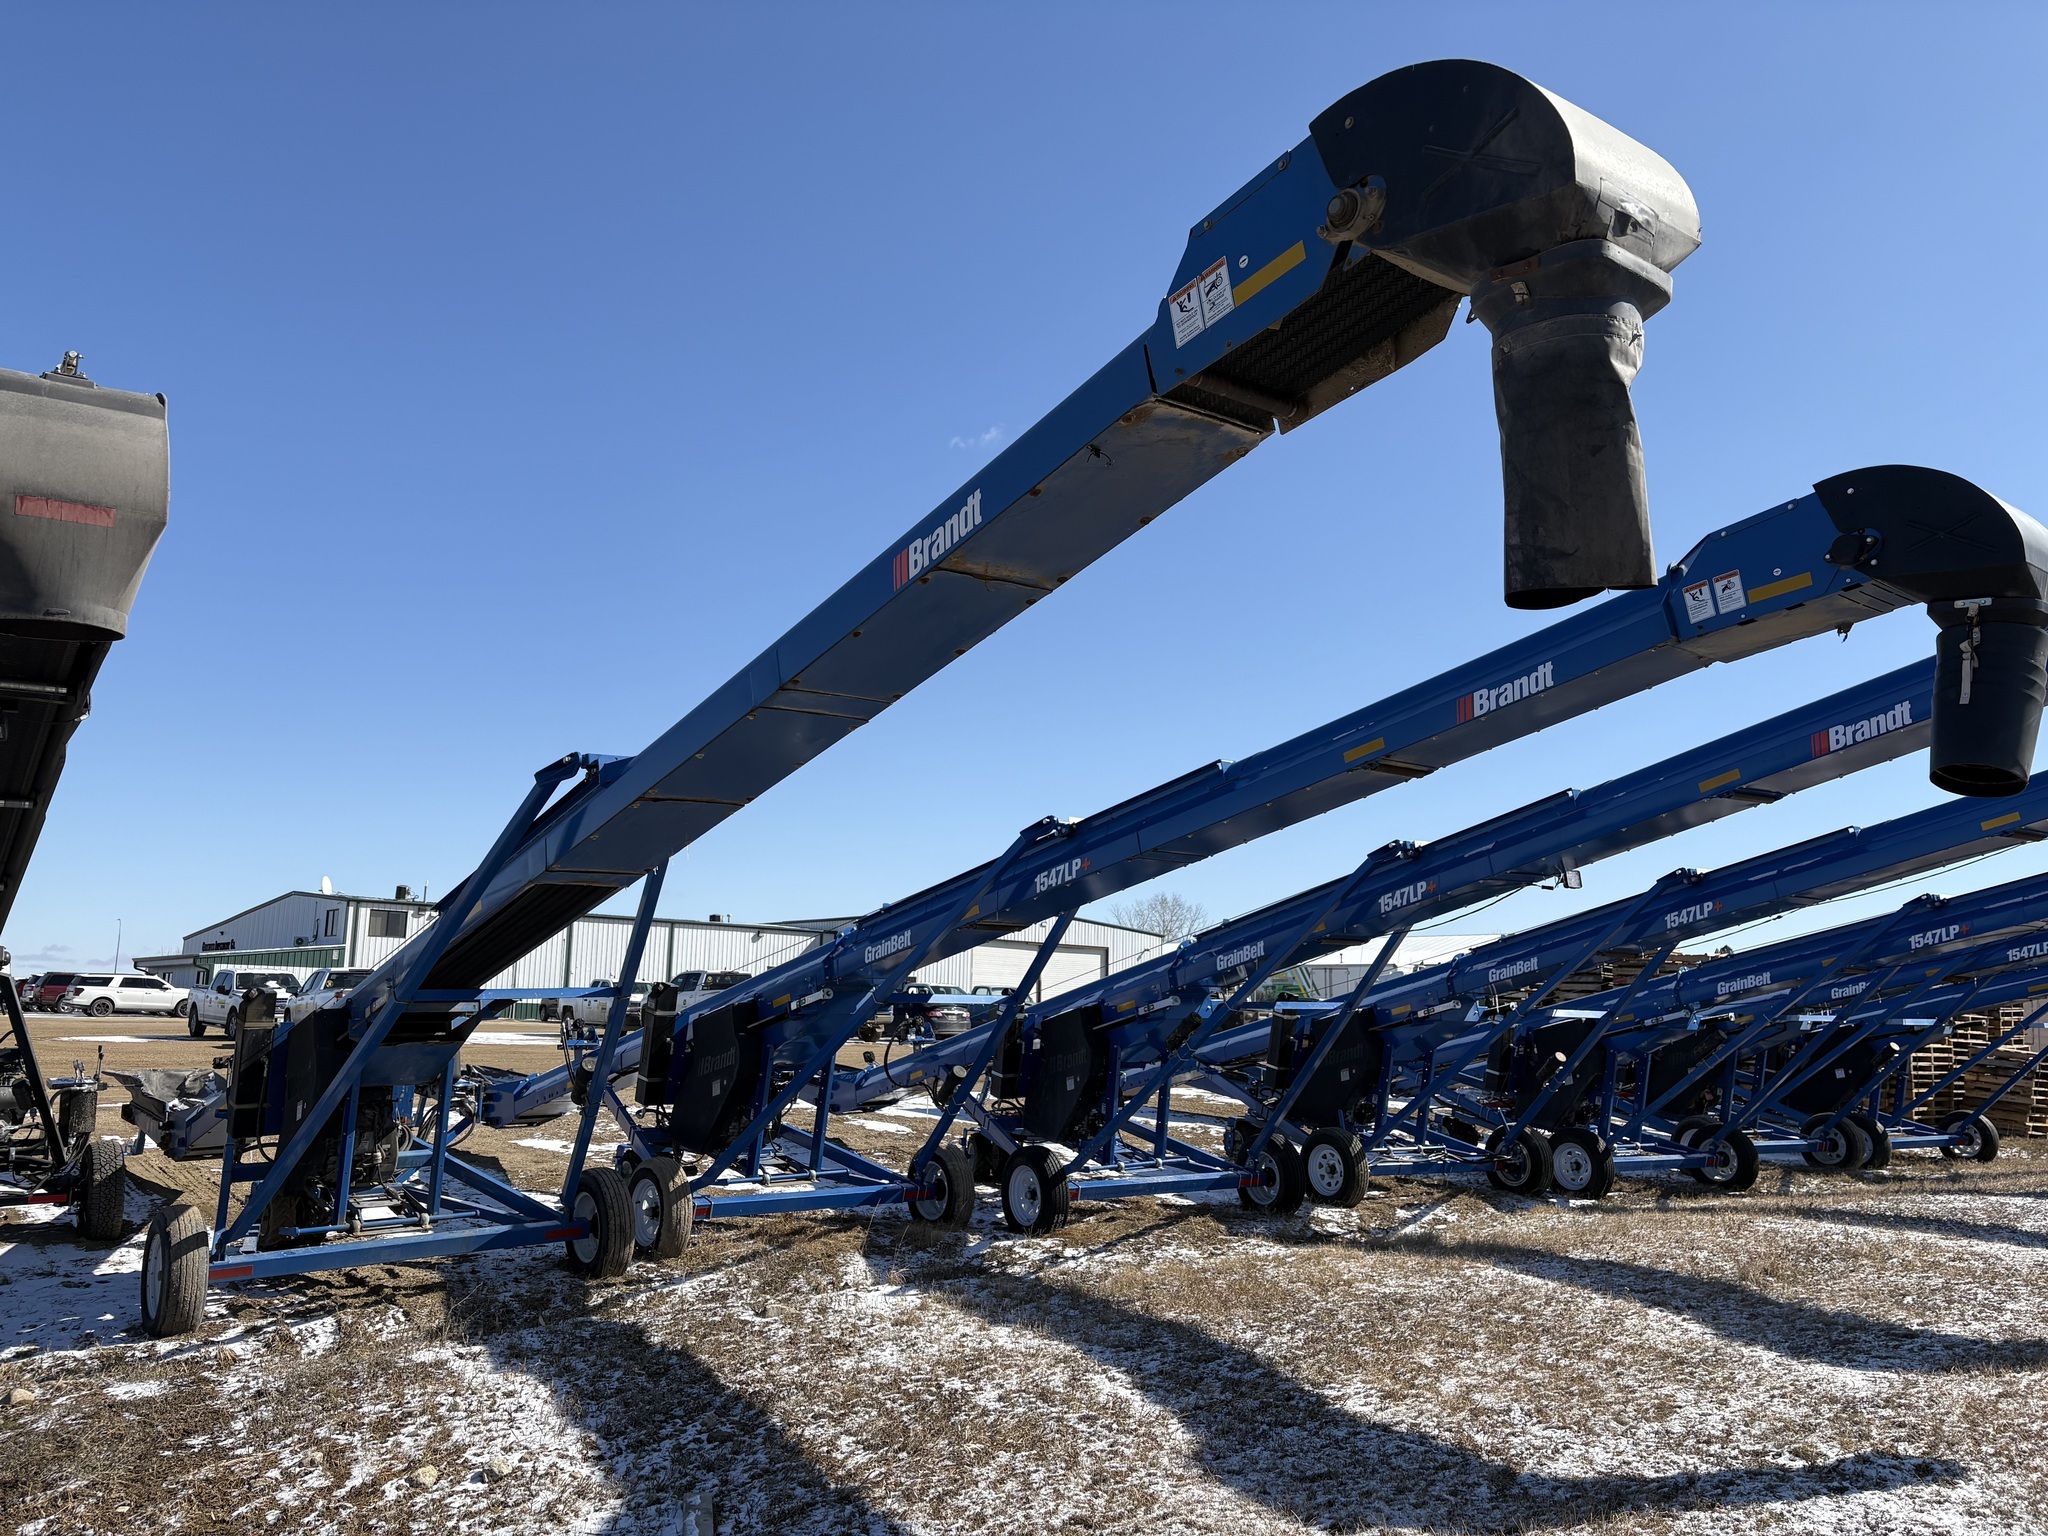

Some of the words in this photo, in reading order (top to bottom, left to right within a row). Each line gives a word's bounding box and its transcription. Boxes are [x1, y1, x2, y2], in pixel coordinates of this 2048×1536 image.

[908, 488, 982, 580] Brandt
[1473, 661, 1554, 718] Brandt
[1829, 700, 1913, 752] Brandt
[864, 930, 912, 964] GrainBelt
[1216, 940, 1265, 972] GrainBelt
[1488, 957, 1539, 983] GrainBelt
[1717, 972, 1772, 996] GrainBelt
